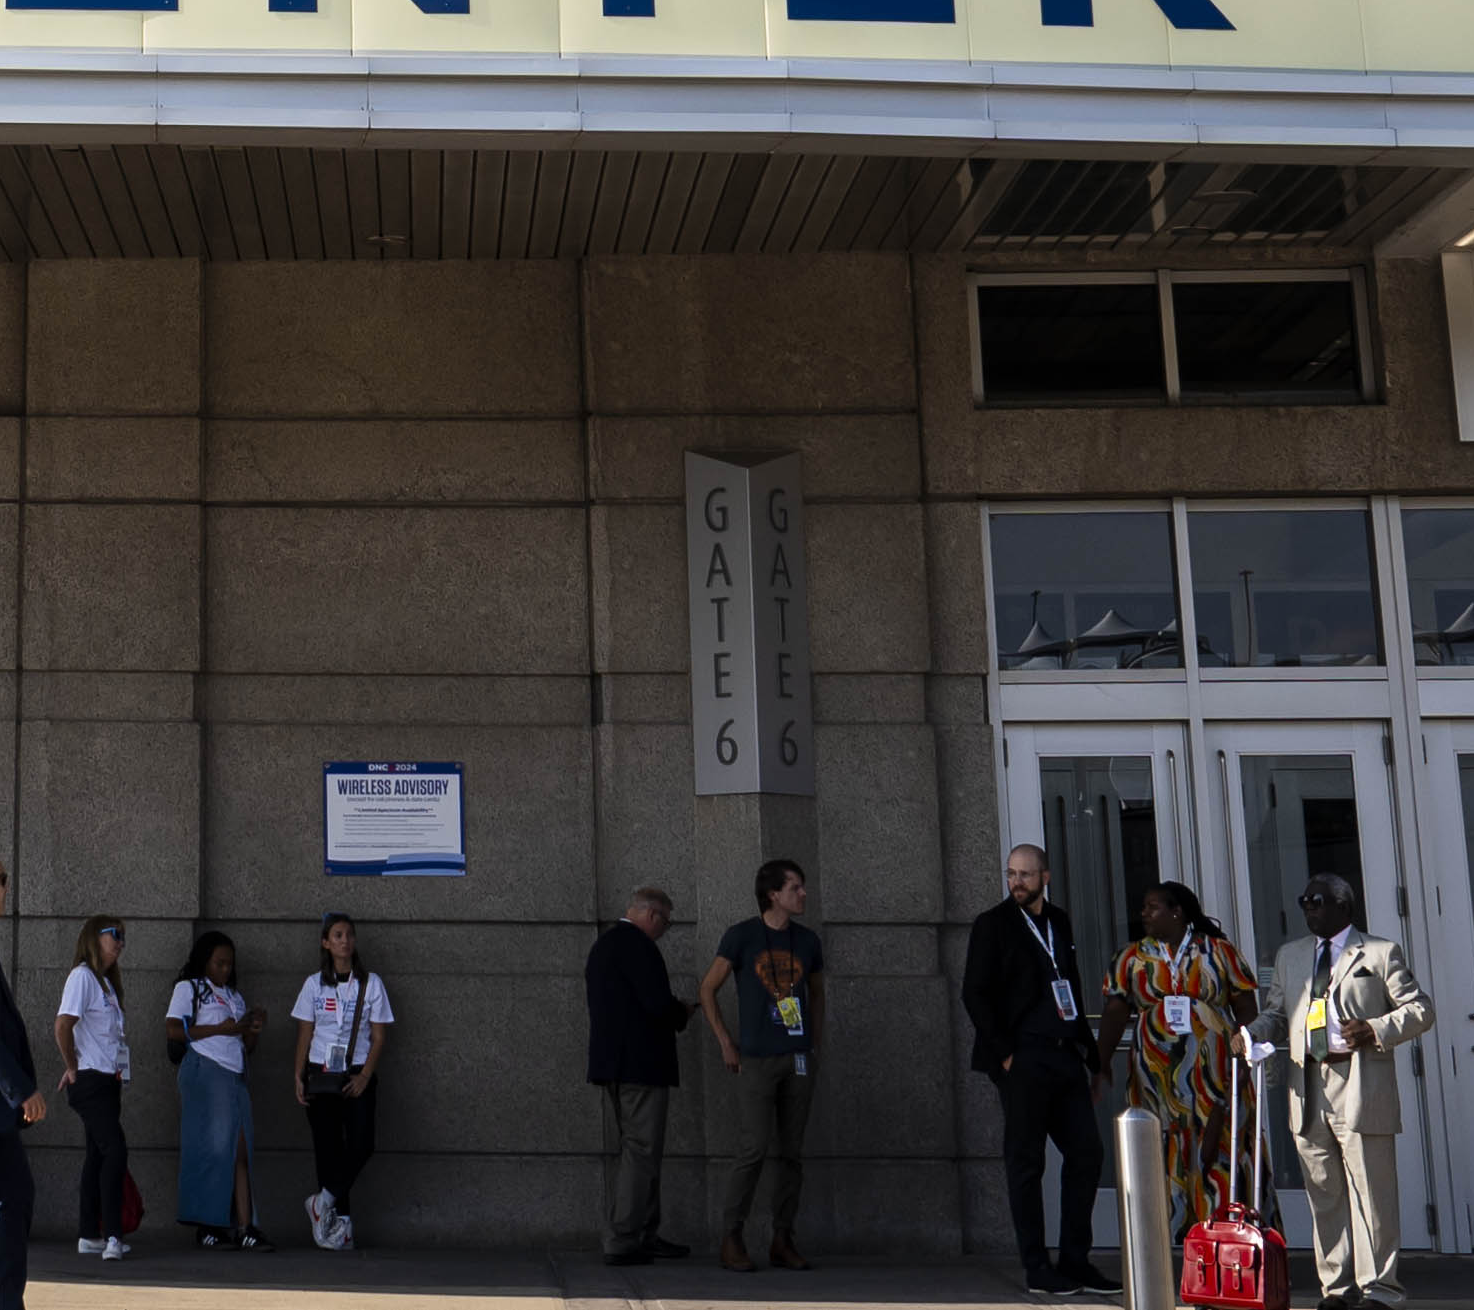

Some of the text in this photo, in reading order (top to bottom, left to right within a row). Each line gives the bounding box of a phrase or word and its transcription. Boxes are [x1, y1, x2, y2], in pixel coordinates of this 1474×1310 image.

[704, 487, 738, 765] GATE 6
[768, 488, 798, 767] GATE 6
[338, 779, 449, 795] WIRELESS ADVISORY
